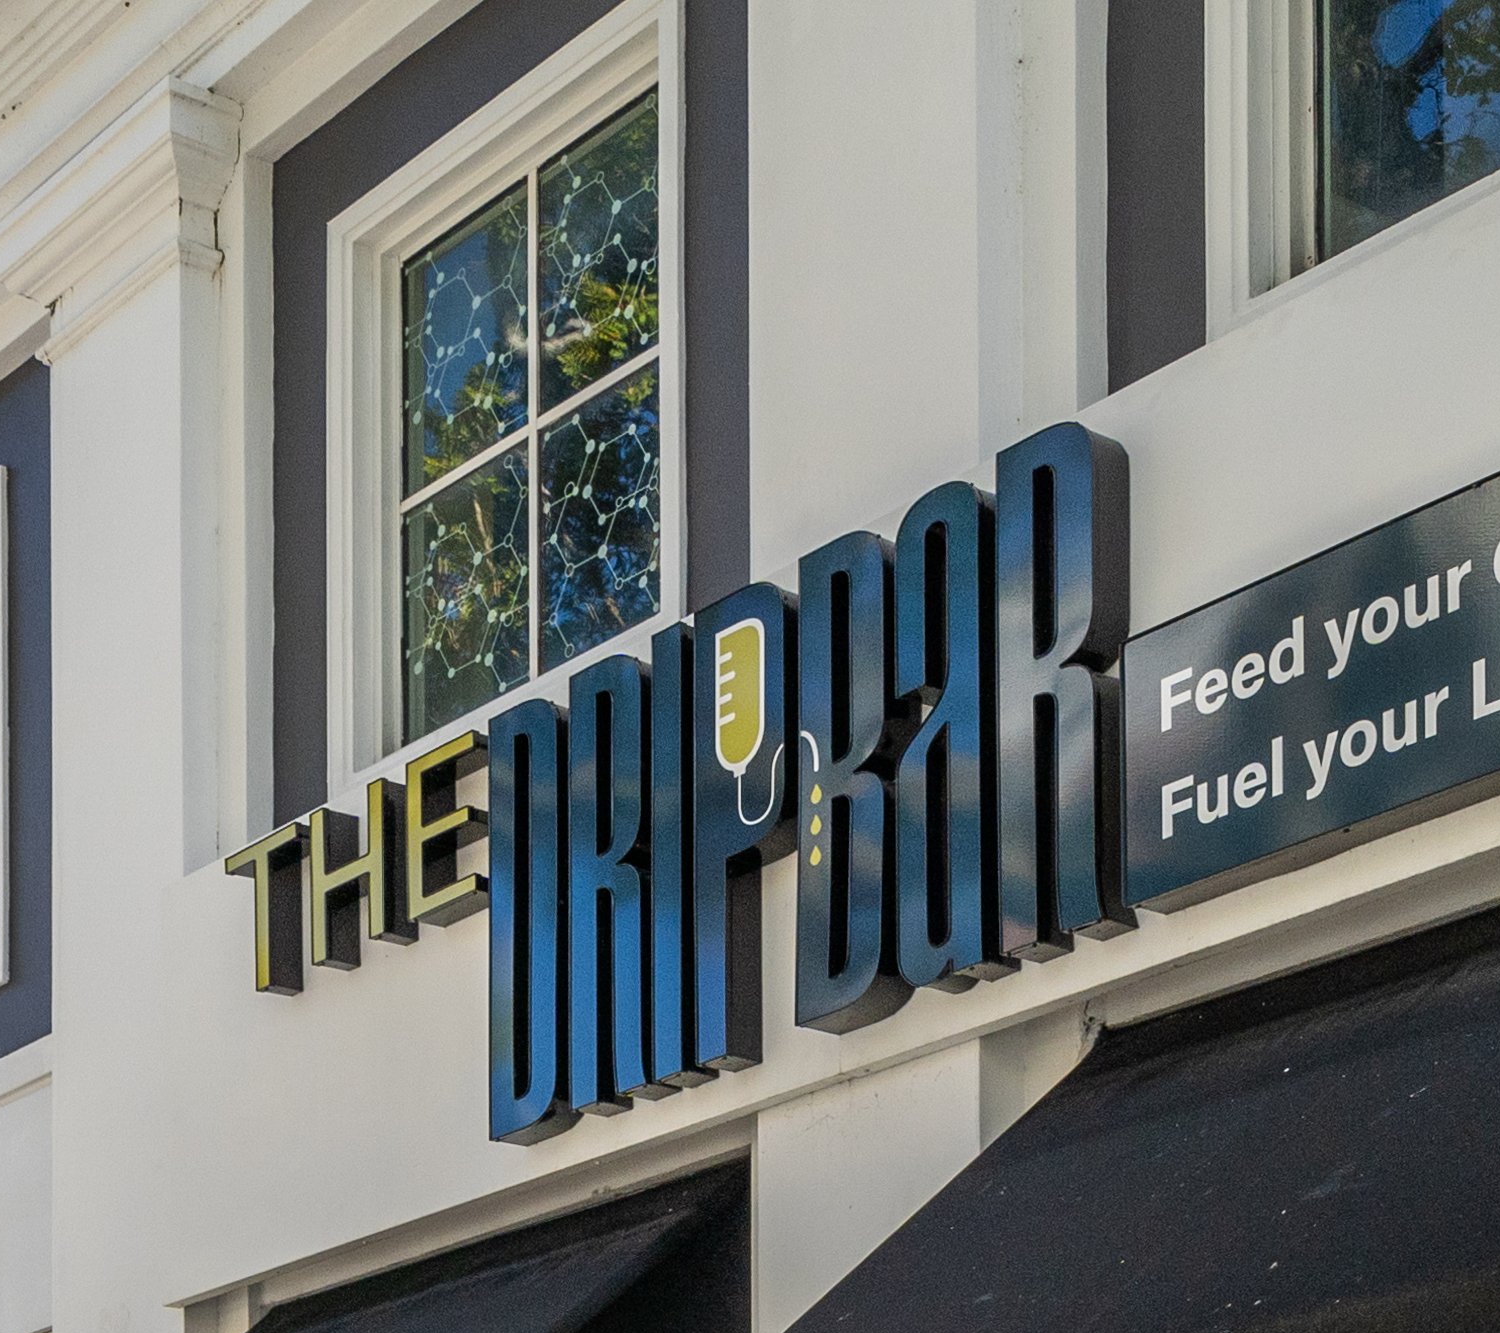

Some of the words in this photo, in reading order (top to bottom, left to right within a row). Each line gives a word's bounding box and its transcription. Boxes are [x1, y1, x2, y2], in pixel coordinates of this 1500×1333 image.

[1160, 615, 1304, 732] Feed
[1324, 559, 1472, 680] your
[1161, 735, 1283, 840] Fuel
[1303, 685, 1449, 800] your
[225, 730, 489, 996] THE
